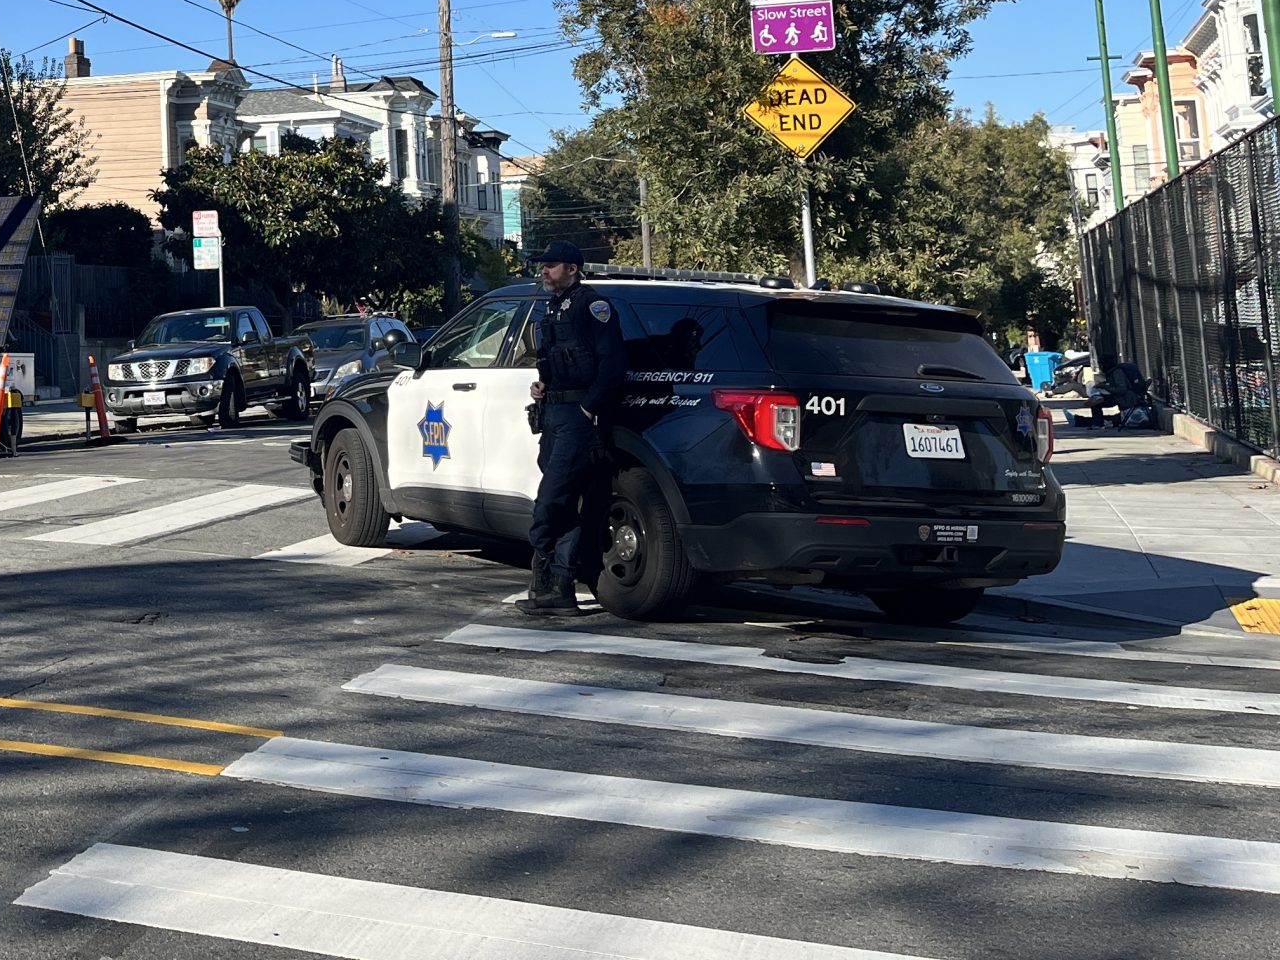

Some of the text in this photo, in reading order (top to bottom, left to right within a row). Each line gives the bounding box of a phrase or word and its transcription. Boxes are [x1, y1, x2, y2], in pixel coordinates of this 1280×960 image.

[757, 5, 827, 21] Slow Street
[770, 88, 827, 107] DEAD
[779, 113, 822, 131] END
[693, 372, 714, 383] 911
[805, 395, 845, 416] 401
[910, 436, 959, 453] 1607467
